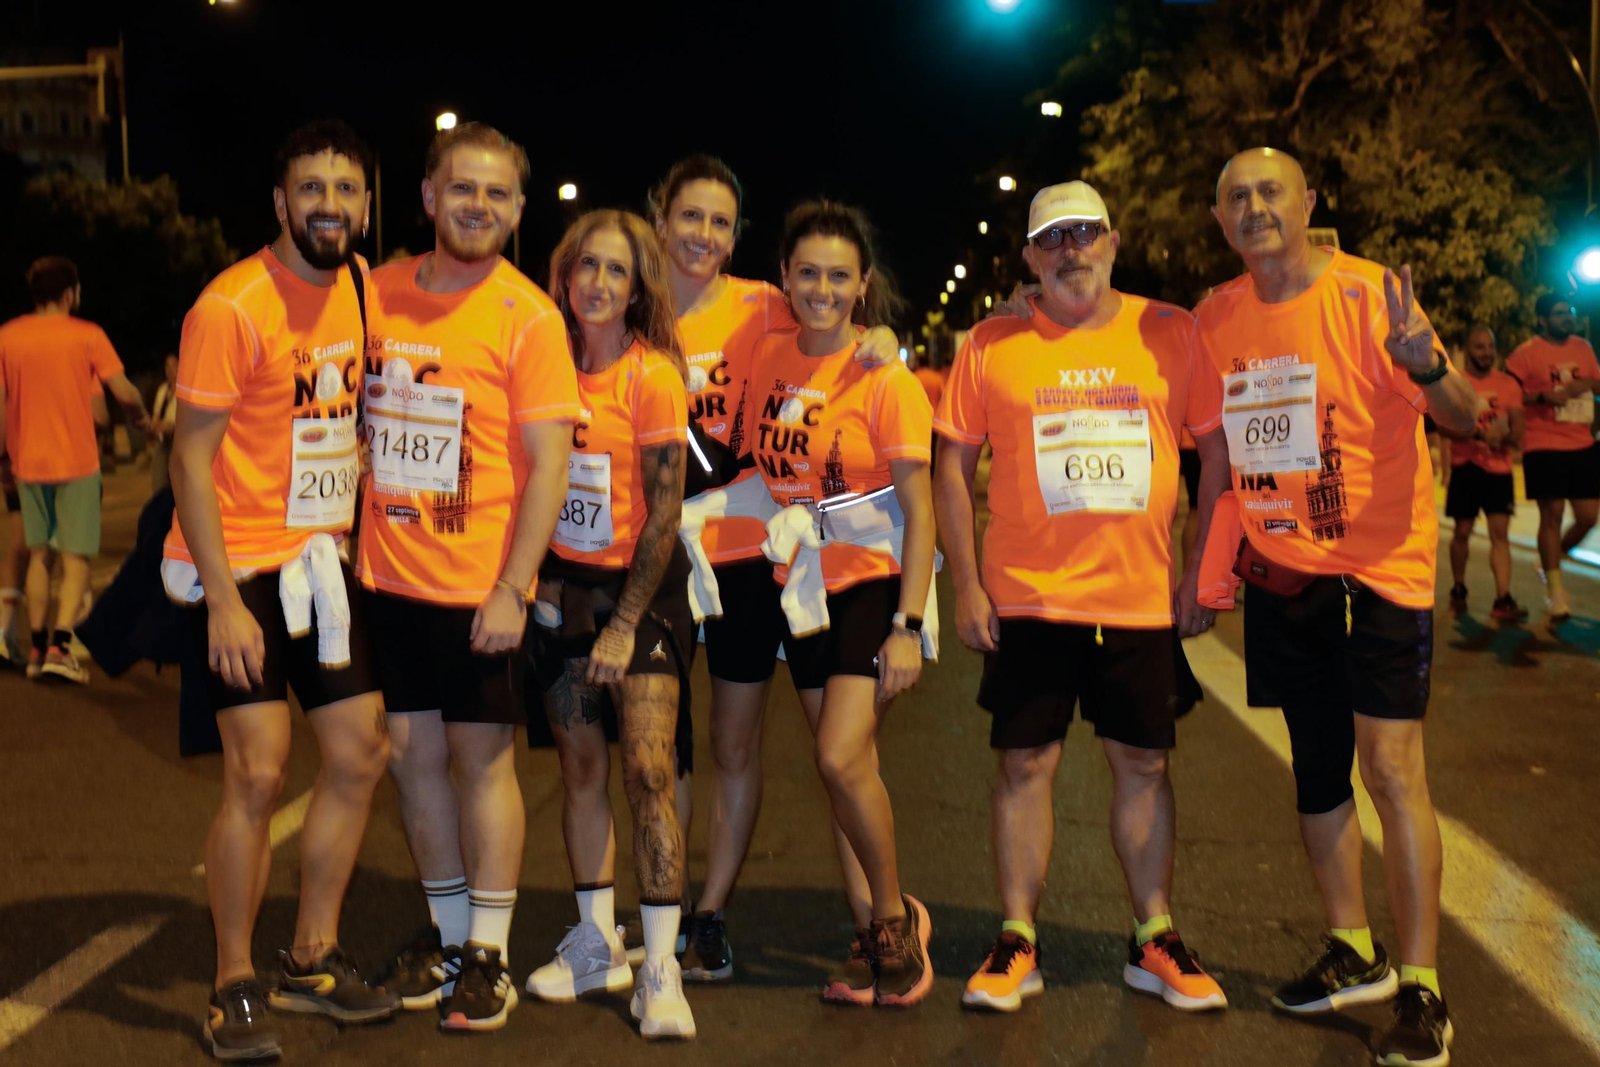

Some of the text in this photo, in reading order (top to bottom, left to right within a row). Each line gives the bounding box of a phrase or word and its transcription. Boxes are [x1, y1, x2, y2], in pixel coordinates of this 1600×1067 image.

[291, 339, 355, 365] 36 CARRERA
[368, 335, 442, 356] 36 CARRERA
[686, 351, 724, 363] ARRERA
[1231, 354, 1300, 373] 36 CARRERA
[1059, 367, 1116, 386] XXXV
[772, 379, 826, 399] 36 CARRERA
[1035, 384, 1139, 396] CARRERA NOCTURNA
[1044, 393, 1139, 406] GUADALQUIVIR
[689, 391, 727, 419] UR
[759, 423, 809, 456] TUR
[1246, 413, 1290, 445] 699
[368, 425, 452, 464] 21487
[759, 453, 798, 478] NA
[1065, 453, 1124, 481] 696
